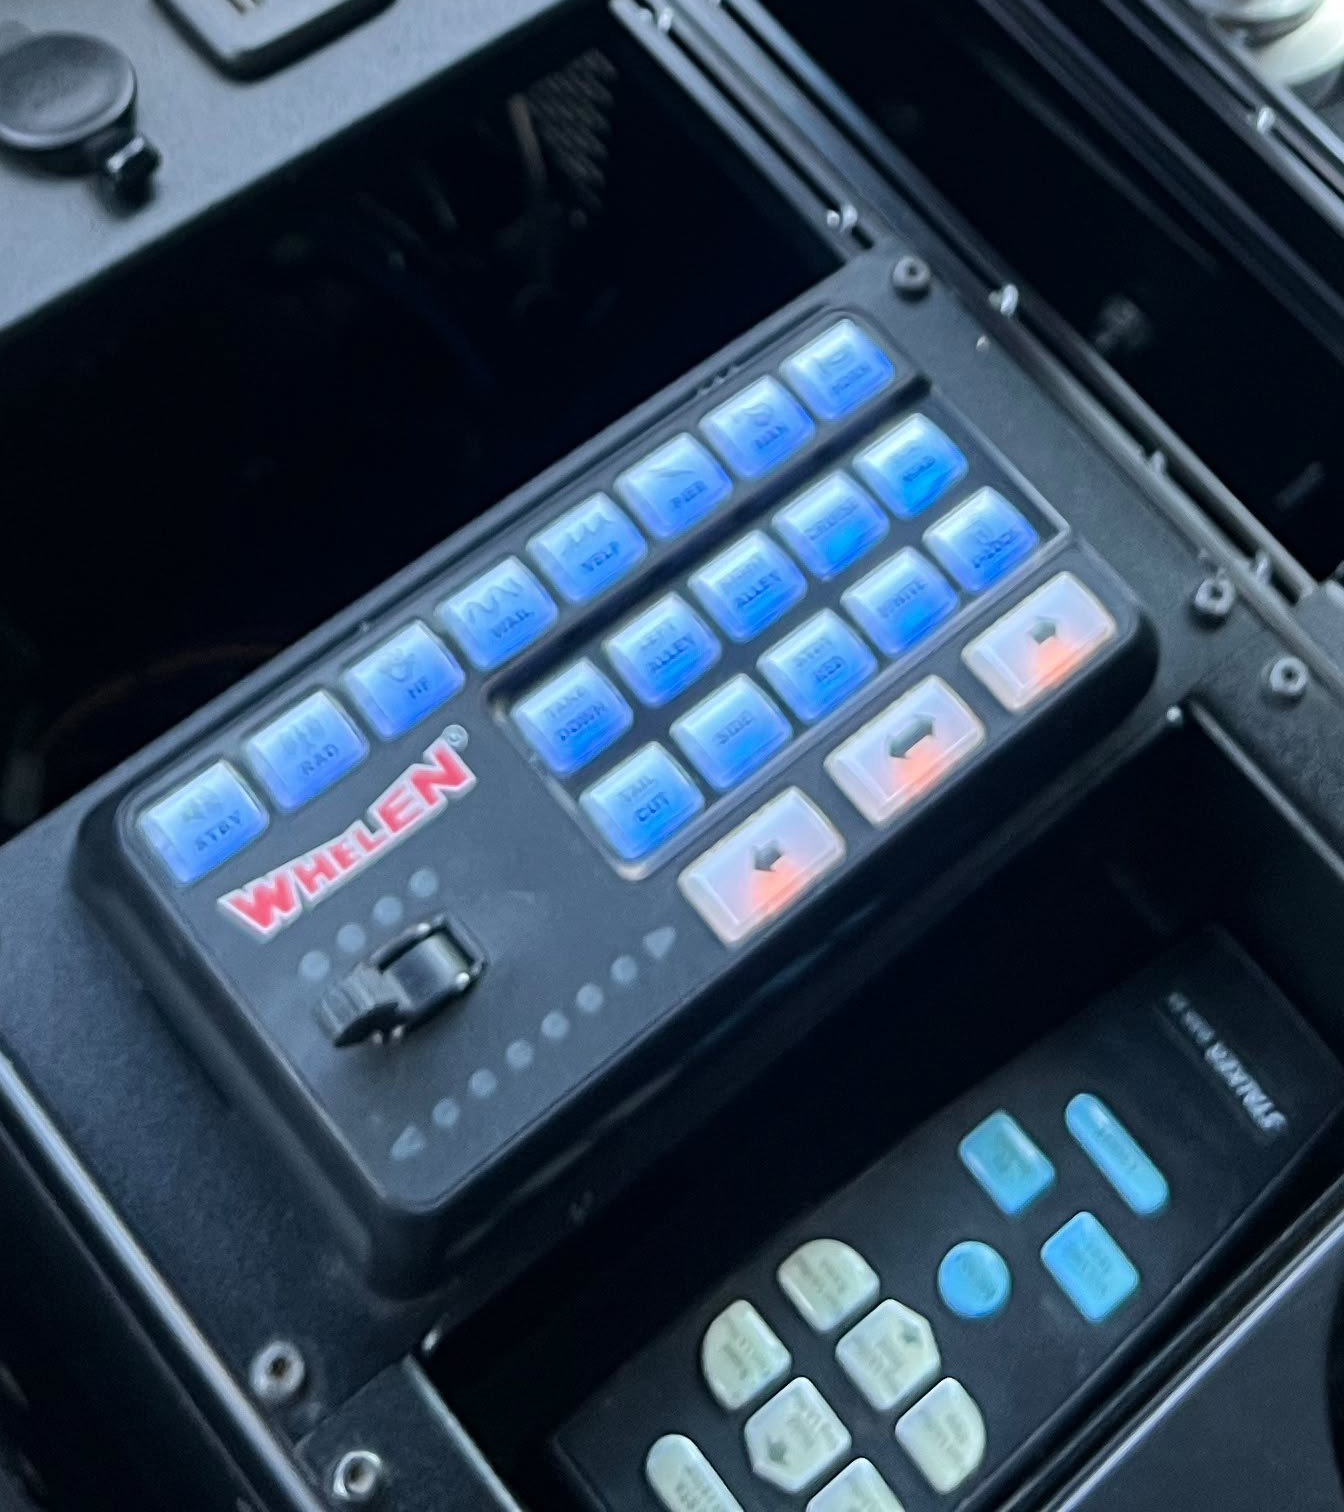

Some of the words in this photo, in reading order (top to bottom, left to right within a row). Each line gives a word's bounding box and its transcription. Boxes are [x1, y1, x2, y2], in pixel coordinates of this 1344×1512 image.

[734, 570, 782, 608] ALLEY
[646, 634, 696, 673] ALLEY
[555, 701, 606, 741] DOWN
[297, 741, 339, 775] RAD
[634, 792, 669, 822] CUT
[219, 738, 476, 940] WHELEN
